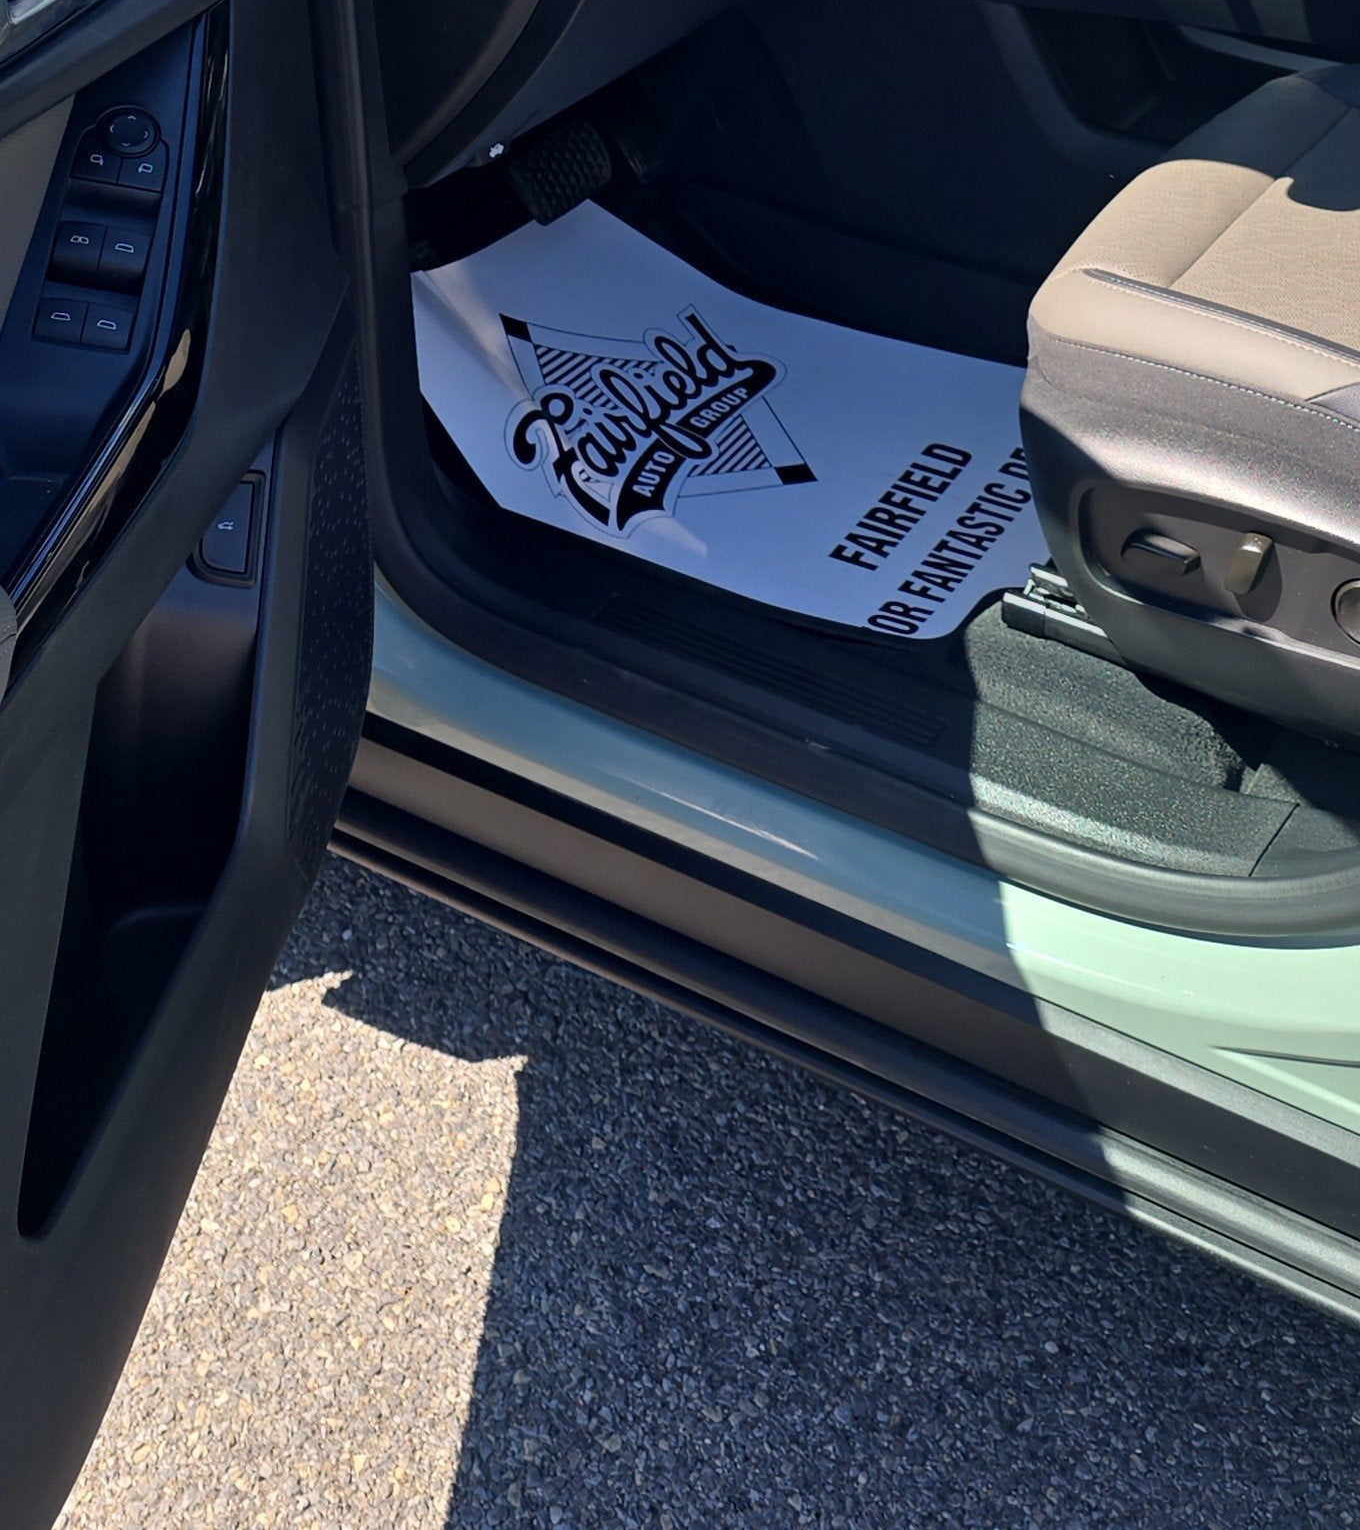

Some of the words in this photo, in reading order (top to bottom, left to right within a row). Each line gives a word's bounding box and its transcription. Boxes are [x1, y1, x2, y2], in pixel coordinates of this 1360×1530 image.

[513, 313, 752, 528] Fairfield
[631, 449, 676, 499] AUTO
[689, 386, 749, 429] GROUP
[827, 443, 973, 571] FAIRFIELD
[897, 482, 1032, 603] FANTASTIC
